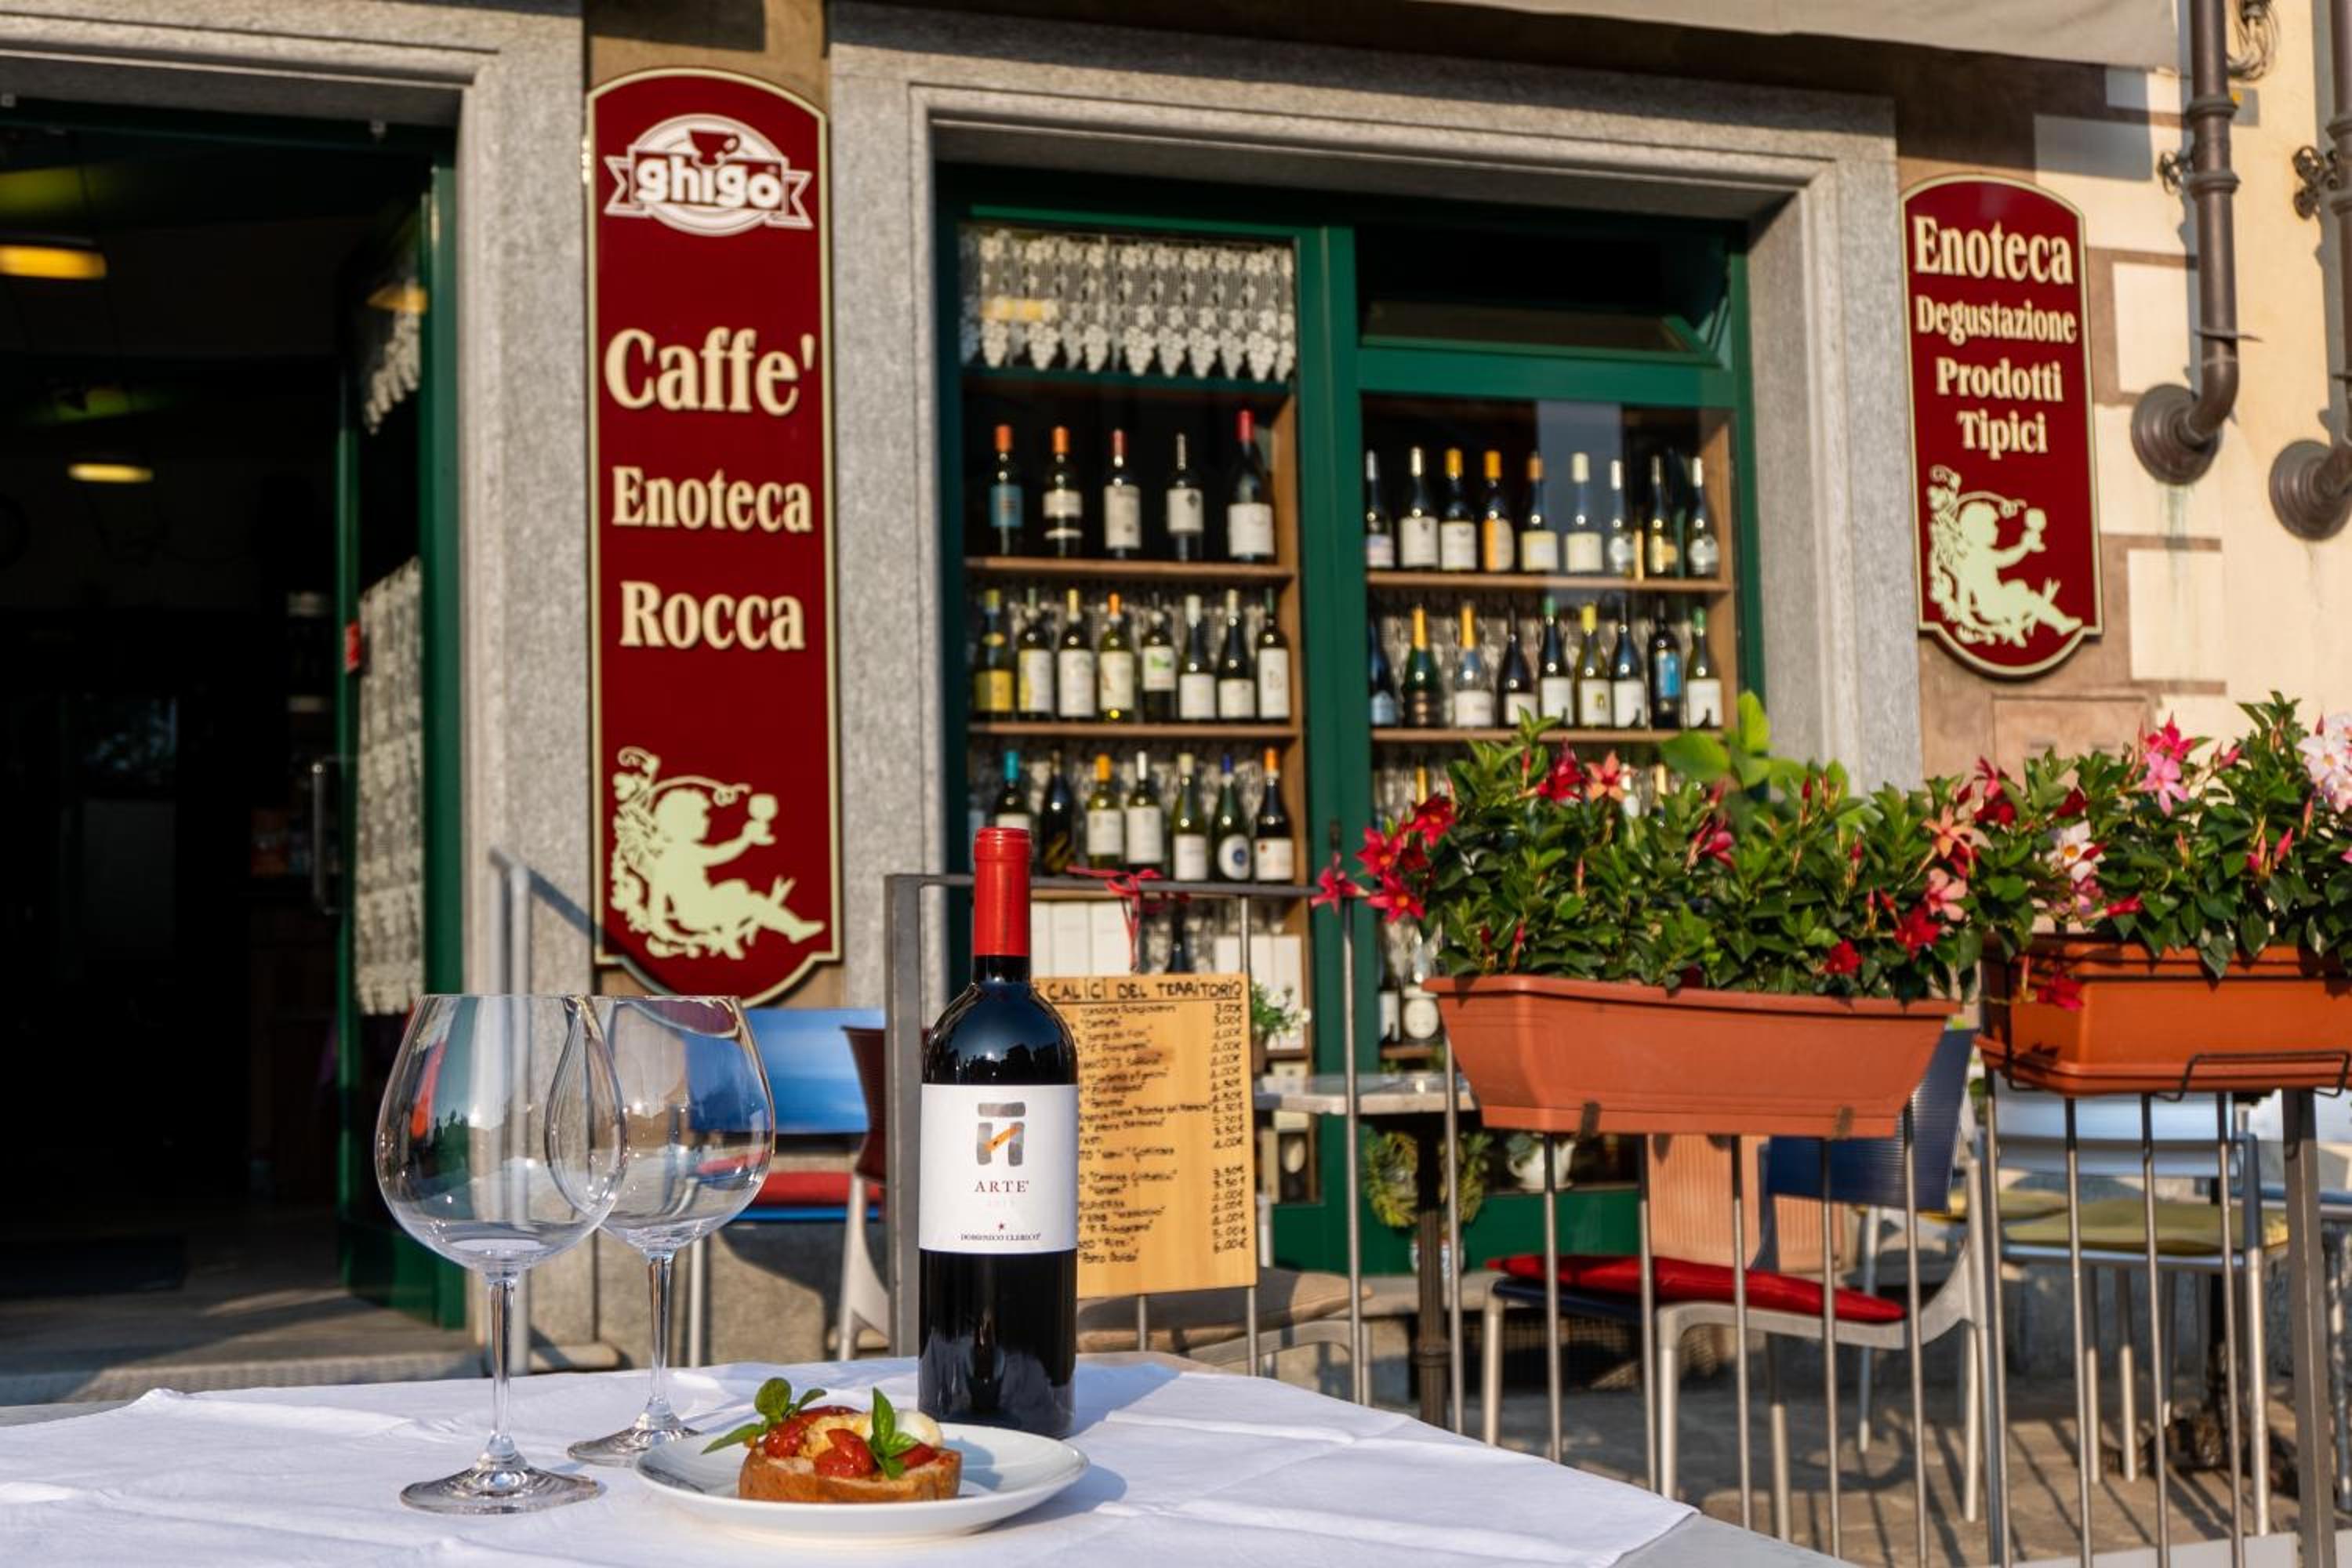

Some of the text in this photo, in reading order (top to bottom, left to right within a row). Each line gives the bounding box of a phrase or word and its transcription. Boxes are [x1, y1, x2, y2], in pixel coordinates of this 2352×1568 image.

[634, 154, 782, 210] ghigo
[1913, 214, 2074, 285] Enoteca
[1915, 294, 2077, 346] Degustazione
[604, 326, 815, 416] Caffe'
[1936, 356, 2063, 402] Prodotti
[1955, 408, 2049, 461] Tipici
[612, 465, 813, 533] Enoteca
[619, 580, 806, 651] Rocca
[1116, 982, 1148, 999] DEL
